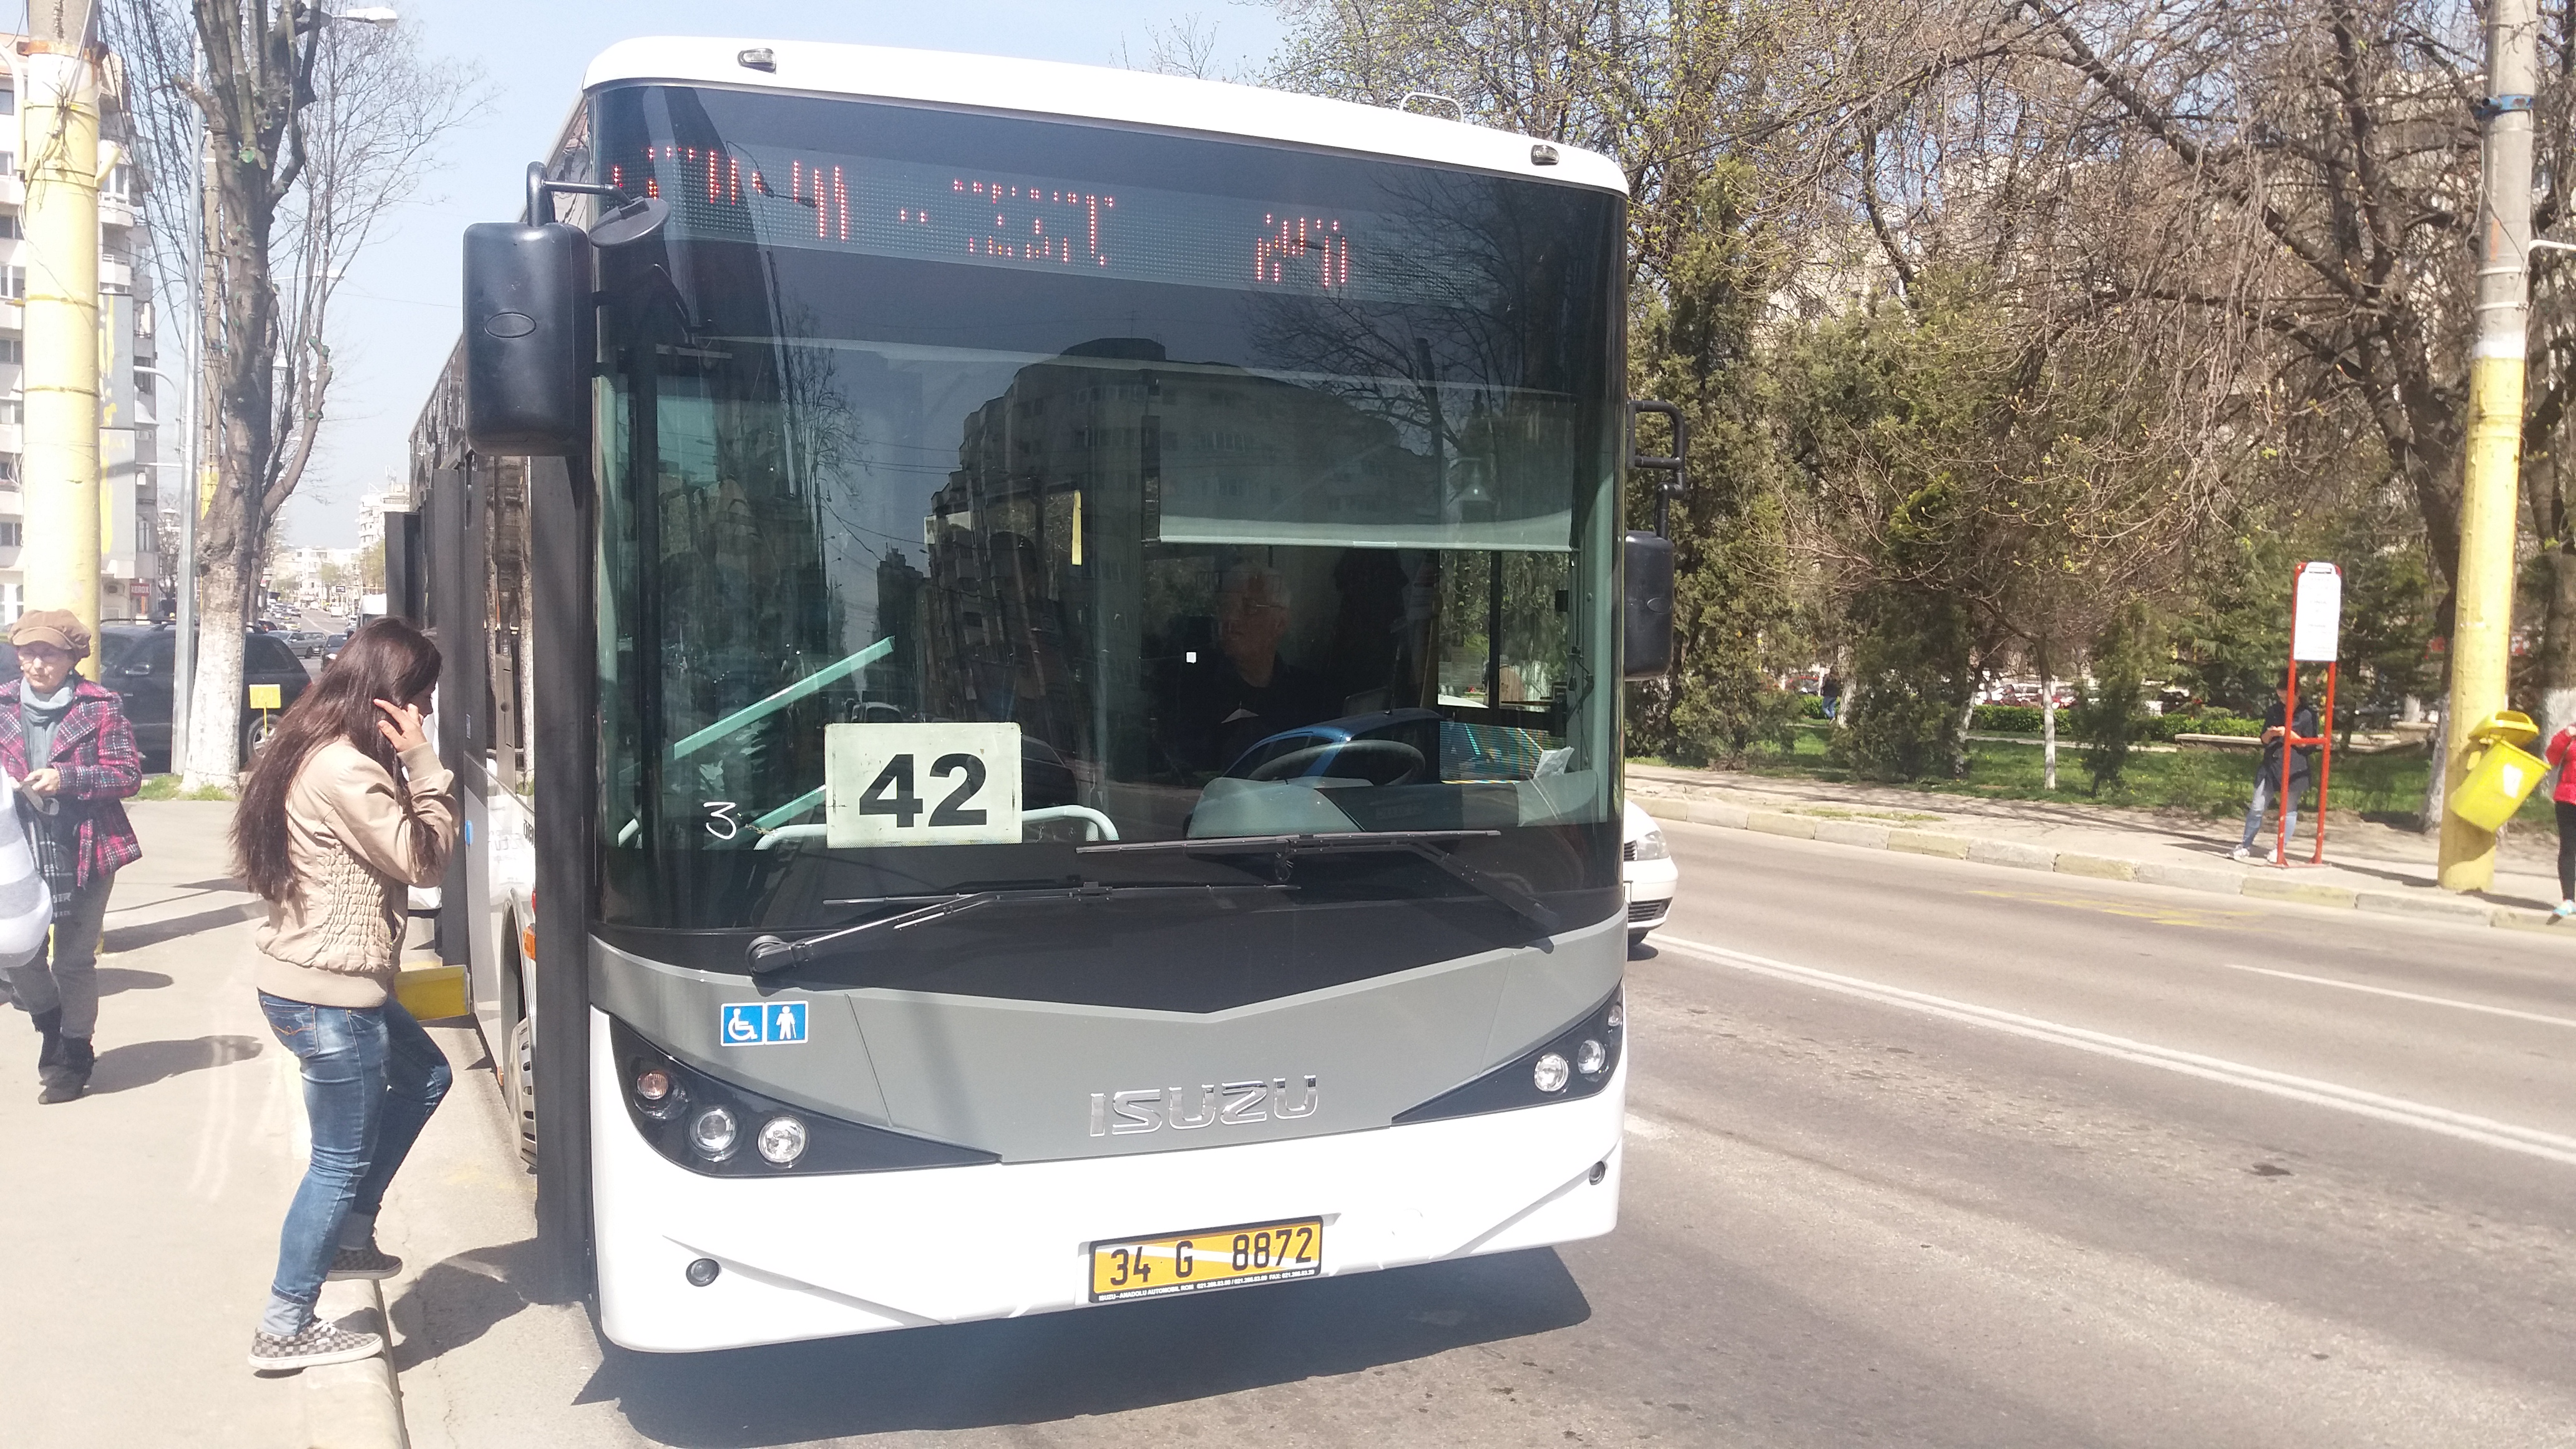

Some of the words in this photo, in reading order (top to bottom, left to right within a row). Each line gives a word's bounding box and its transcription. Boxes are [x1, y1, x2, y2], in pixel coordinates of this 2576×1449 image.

[703, 802, 736, 839] 3
[859, 753, 987, 828] 42
[1090, 1075, 1318, 1137] ISUZU
[1110, 1246, 1151, 1286] 34
[1176, 1240, 1193, 1278] G
[1232, 1227, 1313, 1271] 8872
